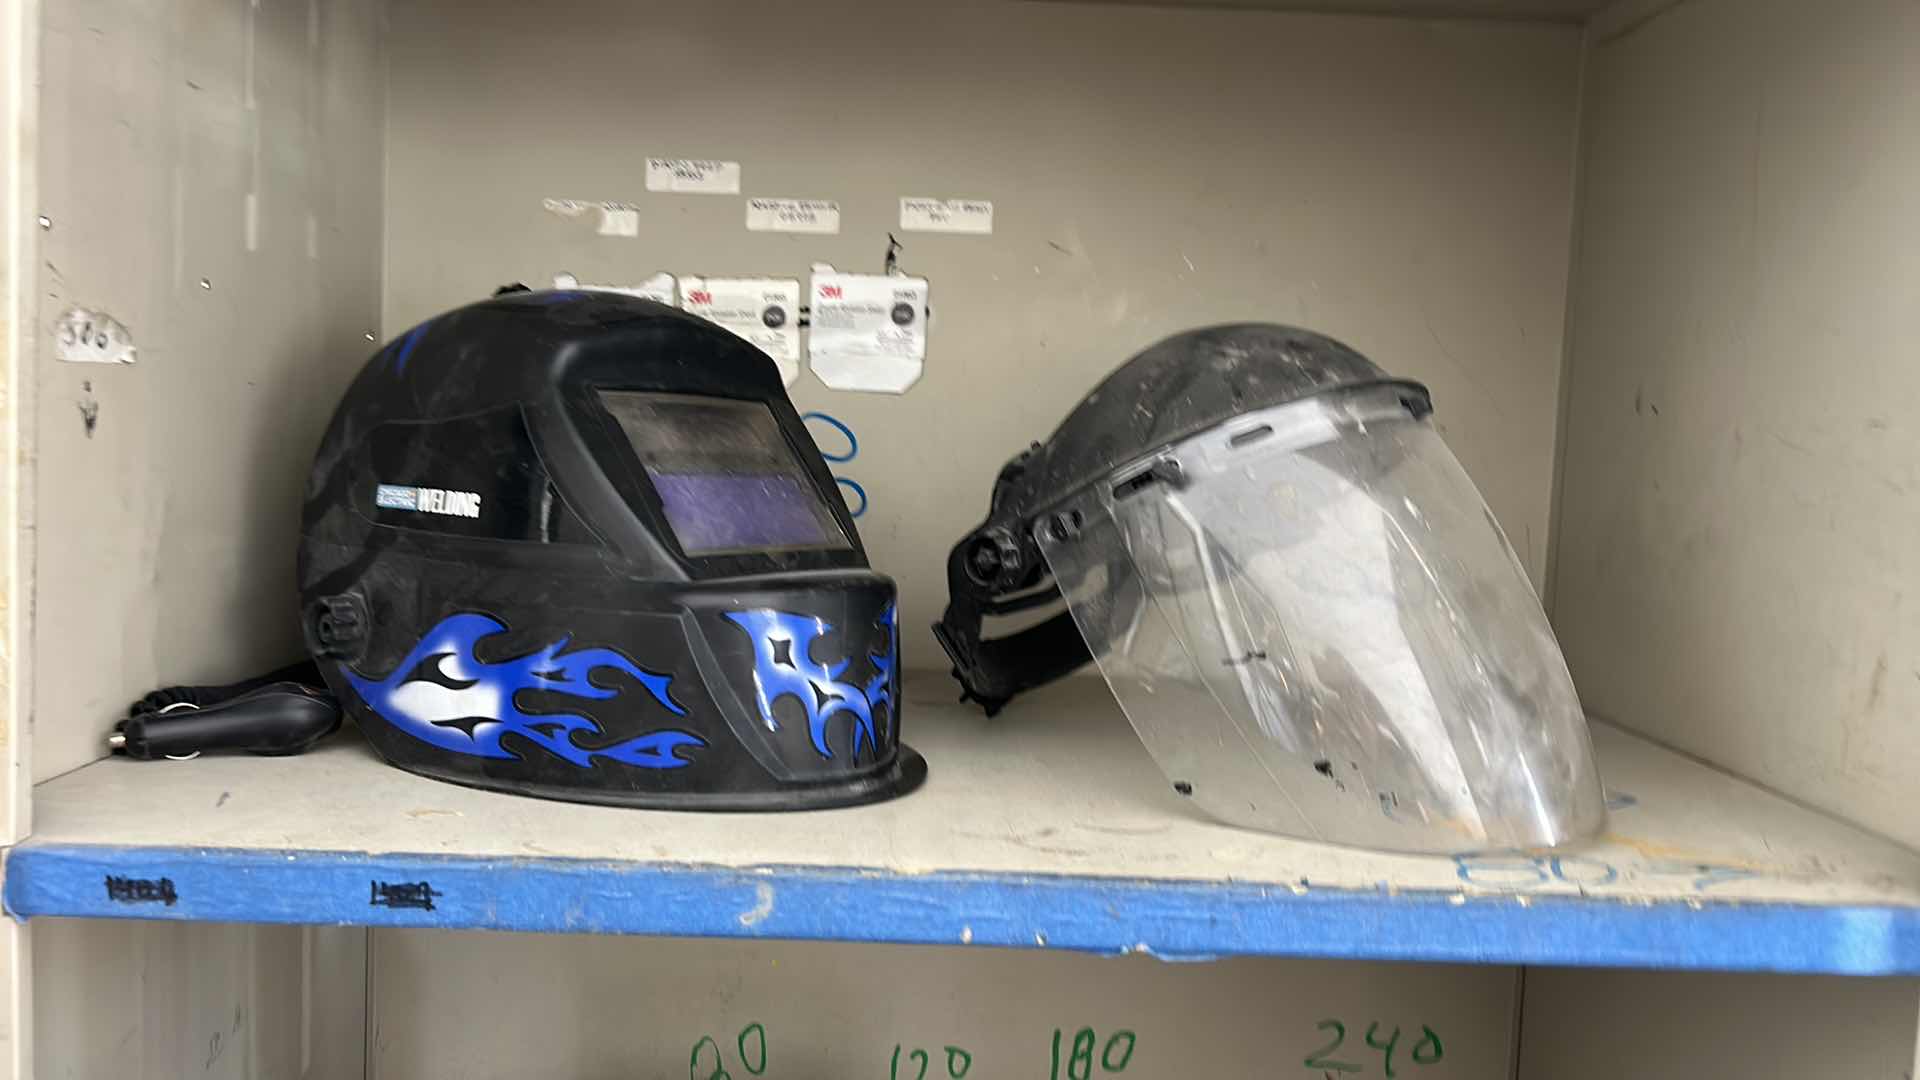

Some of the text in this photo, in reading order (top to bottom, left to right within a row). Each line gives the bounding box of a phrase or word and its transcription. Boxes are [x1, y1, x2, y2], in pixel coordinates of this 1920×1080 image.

[688, 288, 713, 305] 3M
[818, 284, 843, 300] 3M
[416, 486, 482, 519] WELDING
[1303, 1019, 1443, 1079] 240
